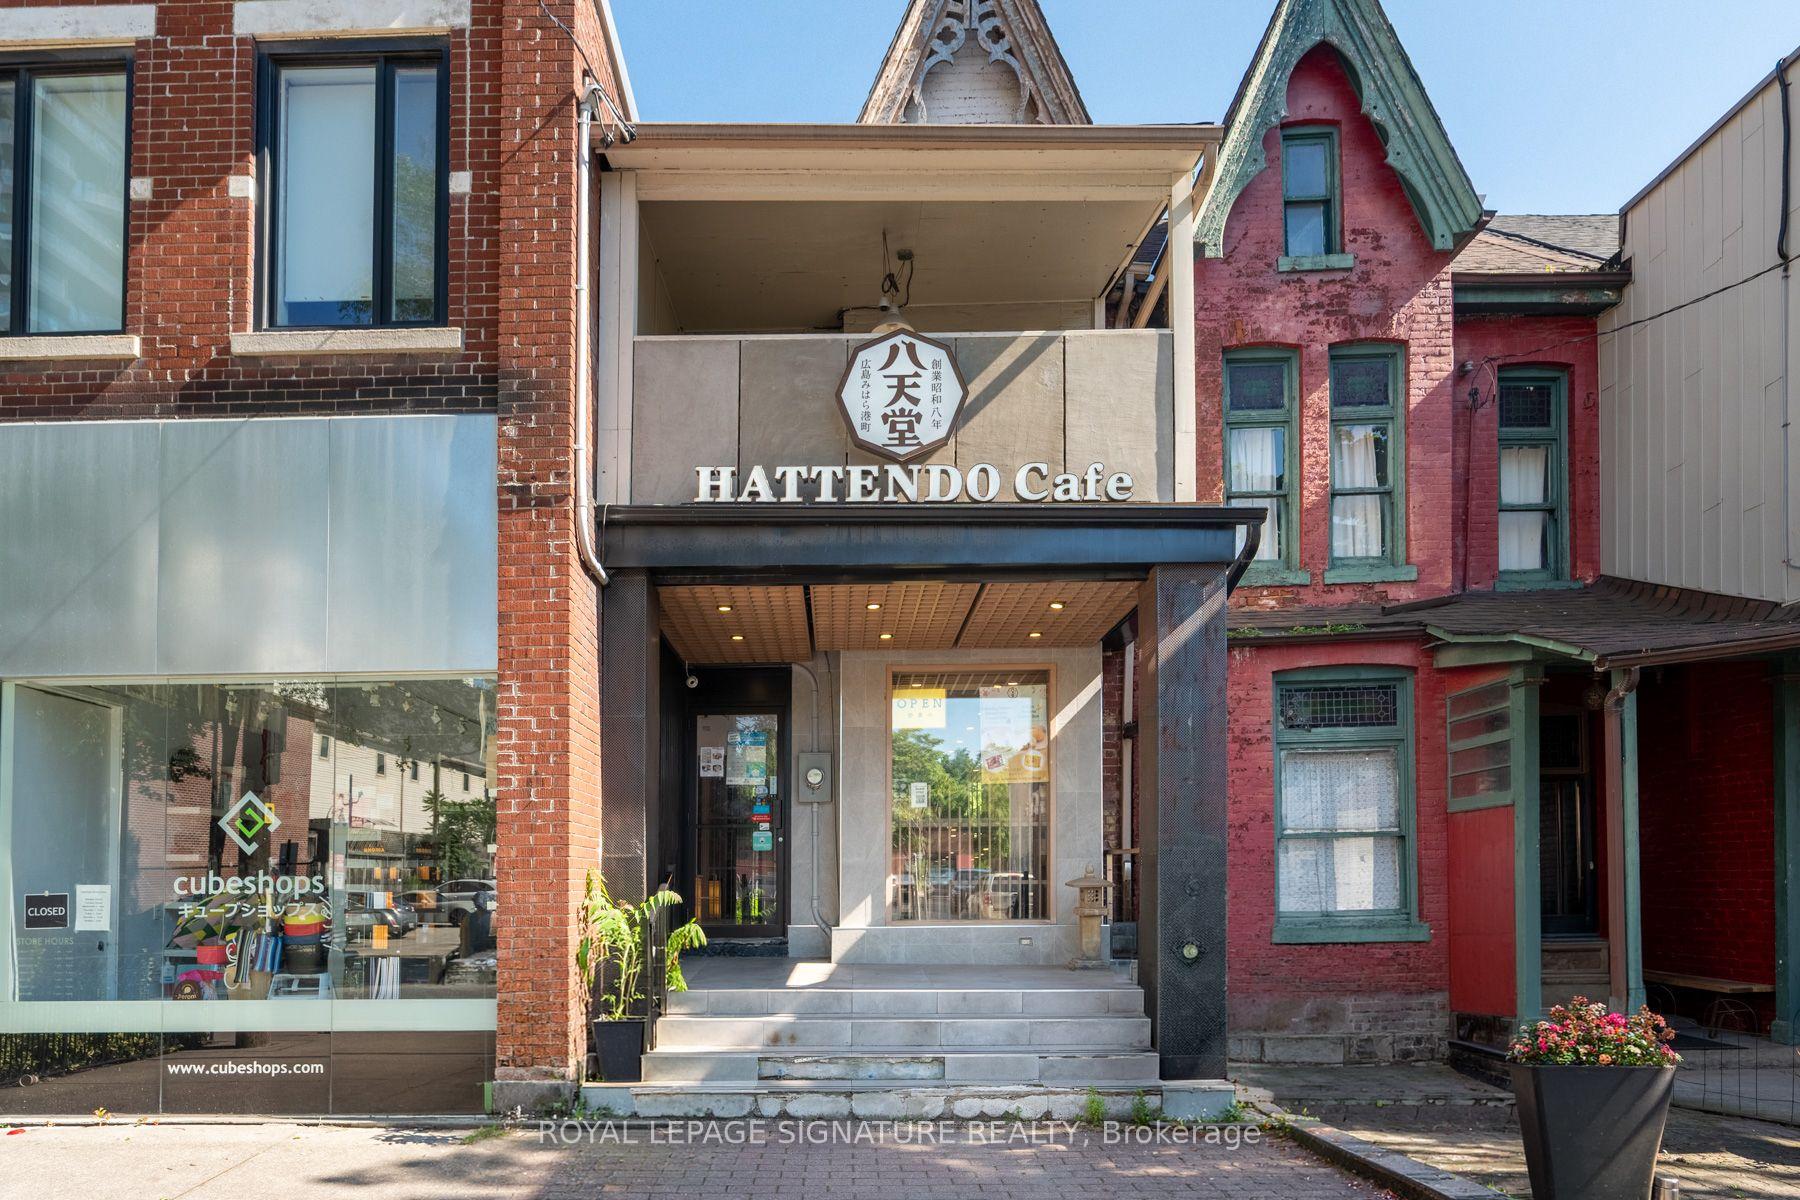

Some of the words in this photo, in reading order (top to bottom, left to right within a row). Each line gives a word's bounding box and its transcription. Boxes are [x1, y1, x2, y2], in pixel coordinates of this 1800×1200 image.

[860, 358, 872, 433] 広島みはら港町
[877, 340, 928, 447] 八天堂
[930, 358, 942, 430] 創業昭和八年
[694, 463, 1001, 502] HATTENDO
[1014, 462, 1134, 502] Cafe
[897, 698, 942, 709] OPEN
[173, 869, 325, 899] cubeshops
[27, 906, 66, 917] CLOSED
[44, 936, 74, 946] HOURS
[168, 1060, 324, 1077] www.cubeshops.com
